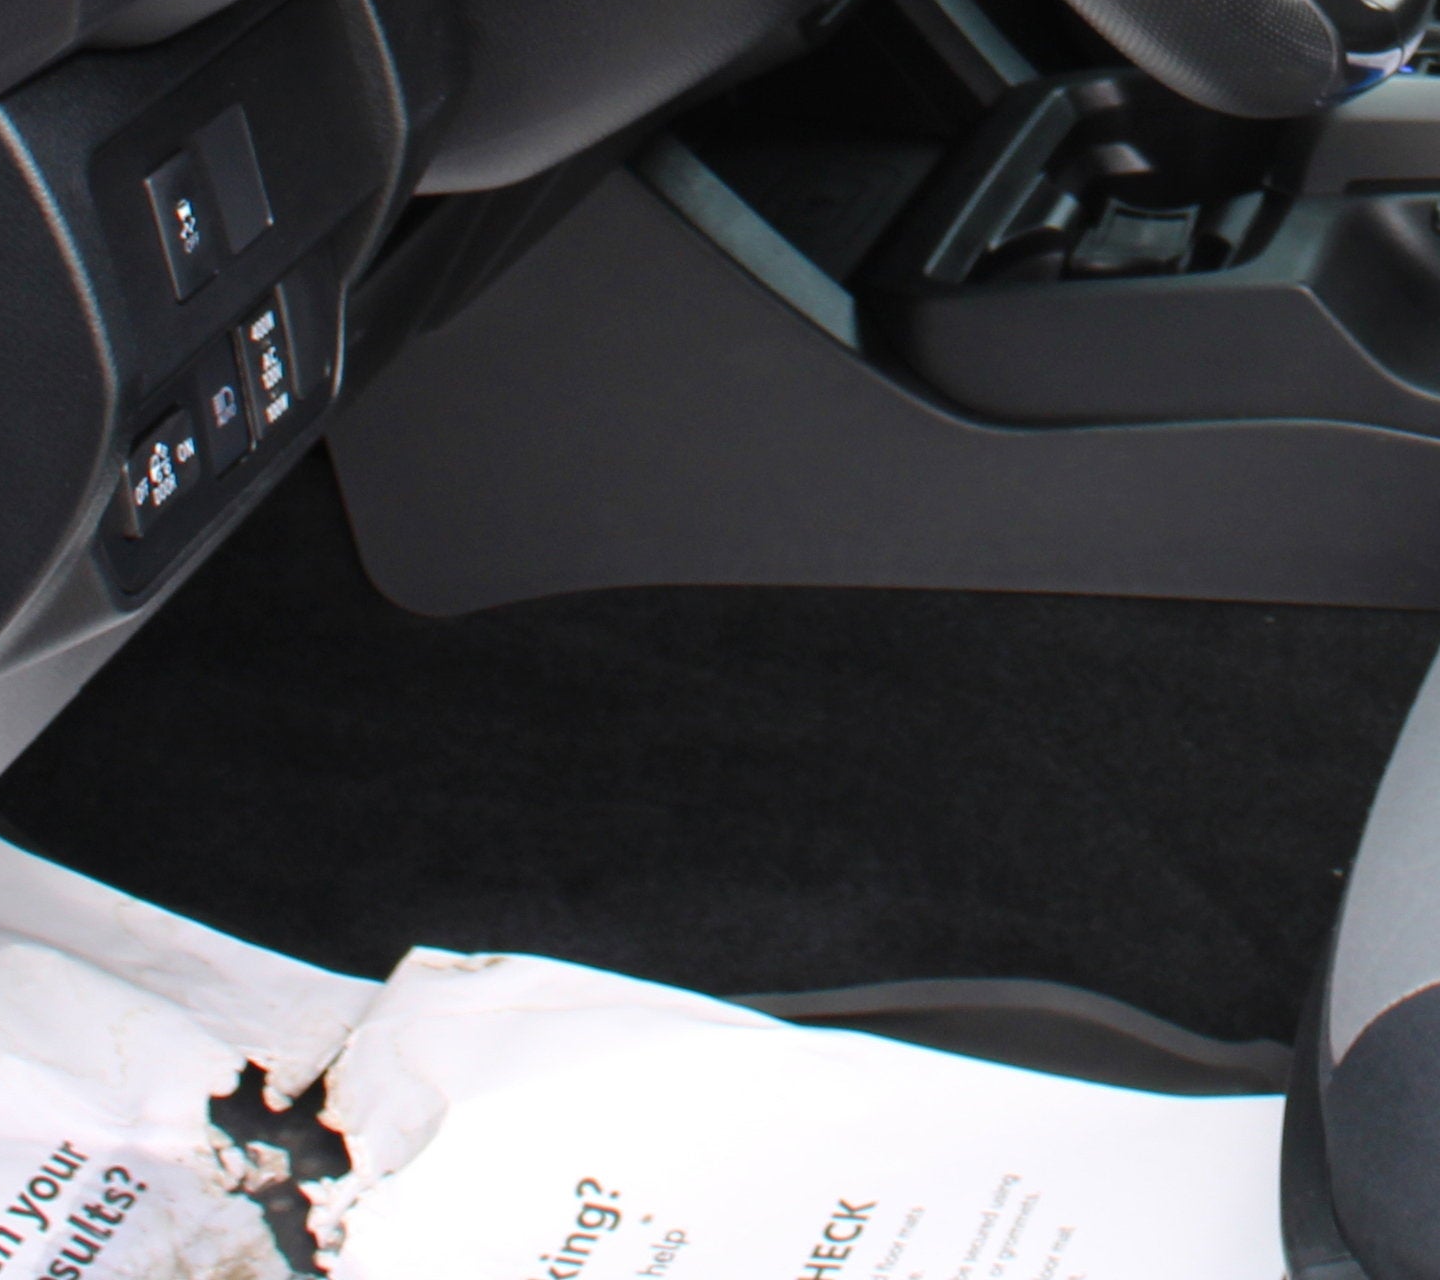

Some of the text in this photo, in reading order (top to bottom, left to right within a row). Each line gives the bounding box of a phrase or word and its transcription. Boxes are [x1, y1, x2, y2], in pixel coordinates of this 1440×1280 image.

[7, 1140, 89, 1232] your
[34, 1165, 148, 1280] sults?
[636, 1228, 690, 1276] help
